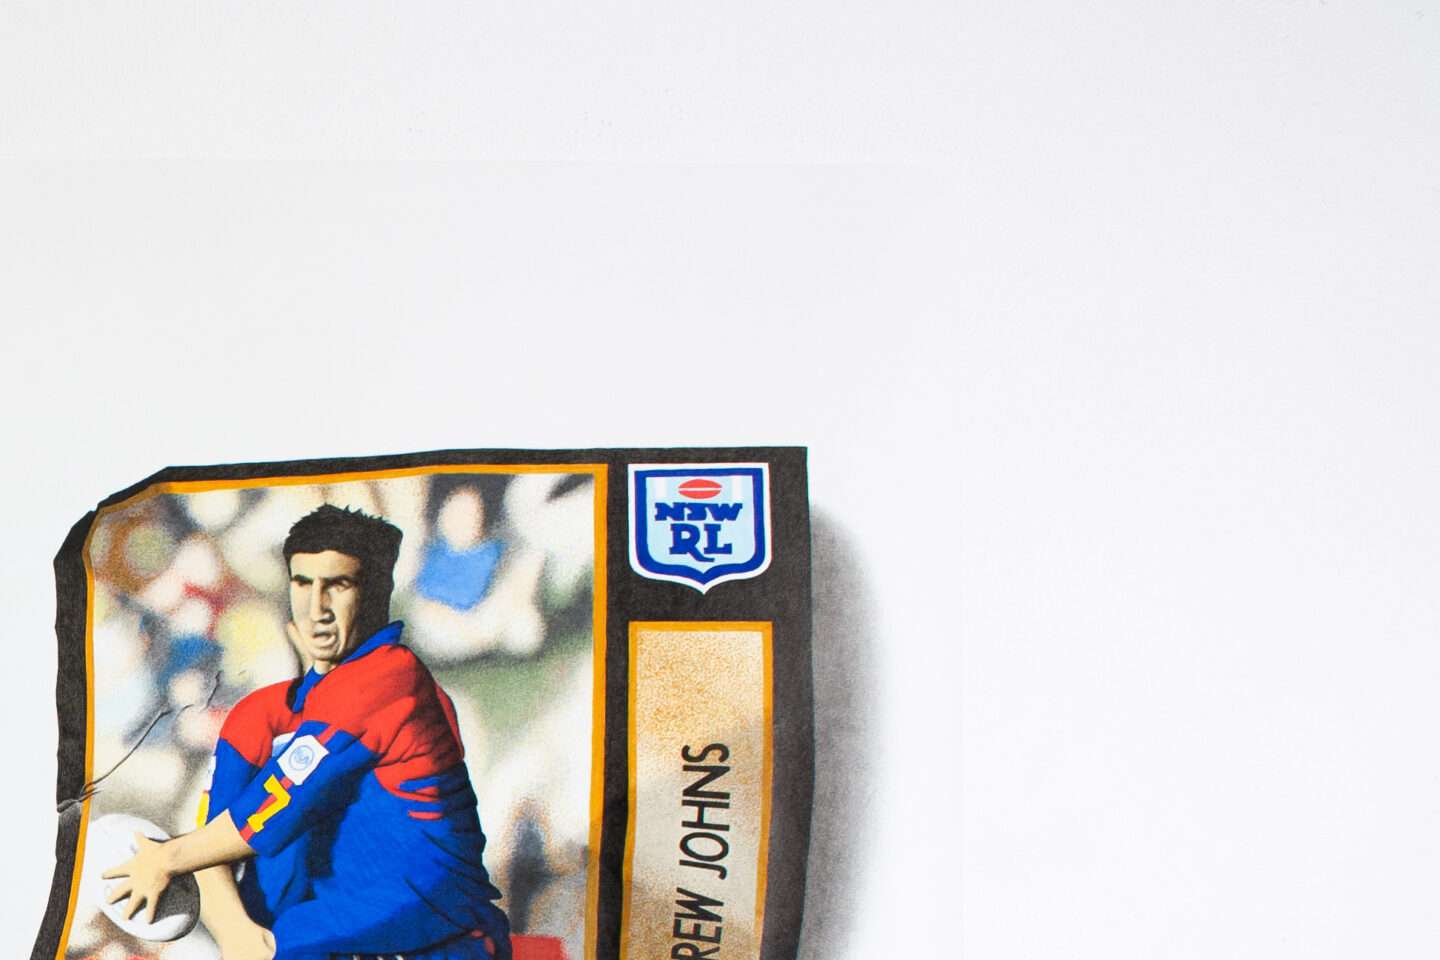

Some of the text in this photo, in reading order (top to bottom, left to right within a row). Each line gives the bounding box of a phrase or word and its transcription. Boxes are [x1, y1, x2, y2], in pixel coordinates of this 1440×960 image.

[654, 502, 743, 521] NSW
[669, 523, 732, 562] RL
[247, 774, 291, 832] 7
[678, 742, 731, 880] JOHNS
